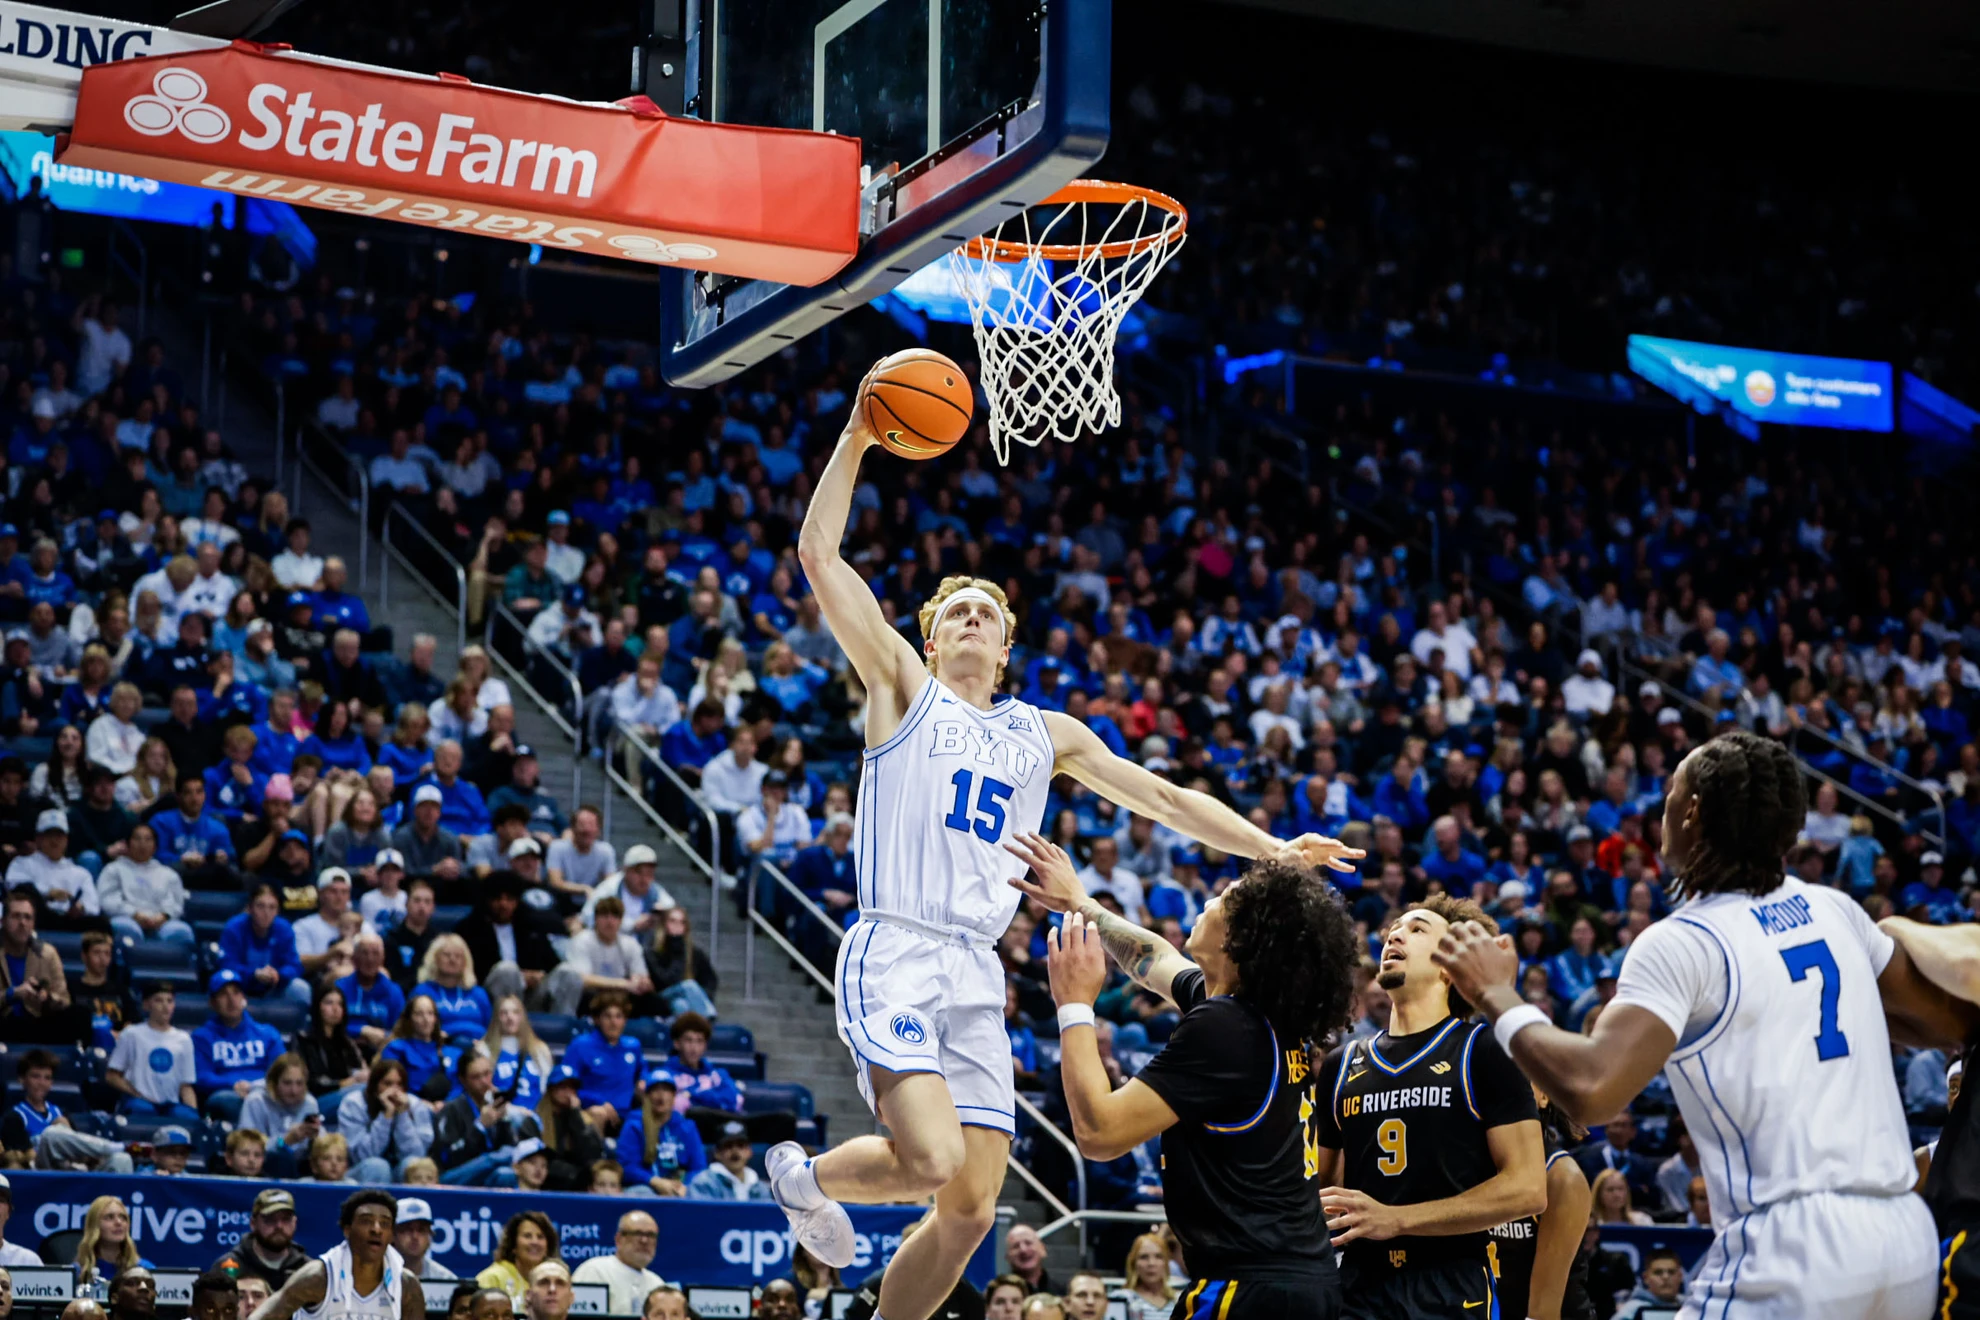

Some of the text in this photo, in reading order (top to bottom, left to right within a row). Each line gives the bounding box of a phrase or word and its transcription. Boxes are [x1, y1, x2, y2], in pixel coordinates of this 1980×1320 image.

[929, 720, 1040, 790] BYU
[945, 768, 1015, 845] 15
[1750, 894, 1814, 937] MBOUP
[1778, 938, 1850, 1062] 7
[1343, 1086, 1453, 1118] UC RIVERSIDE
[1376, 1117, 1408, 1177] 9
[218, 1210, 251, 1228] pes
[561, 1222, 600, 1240] pest
